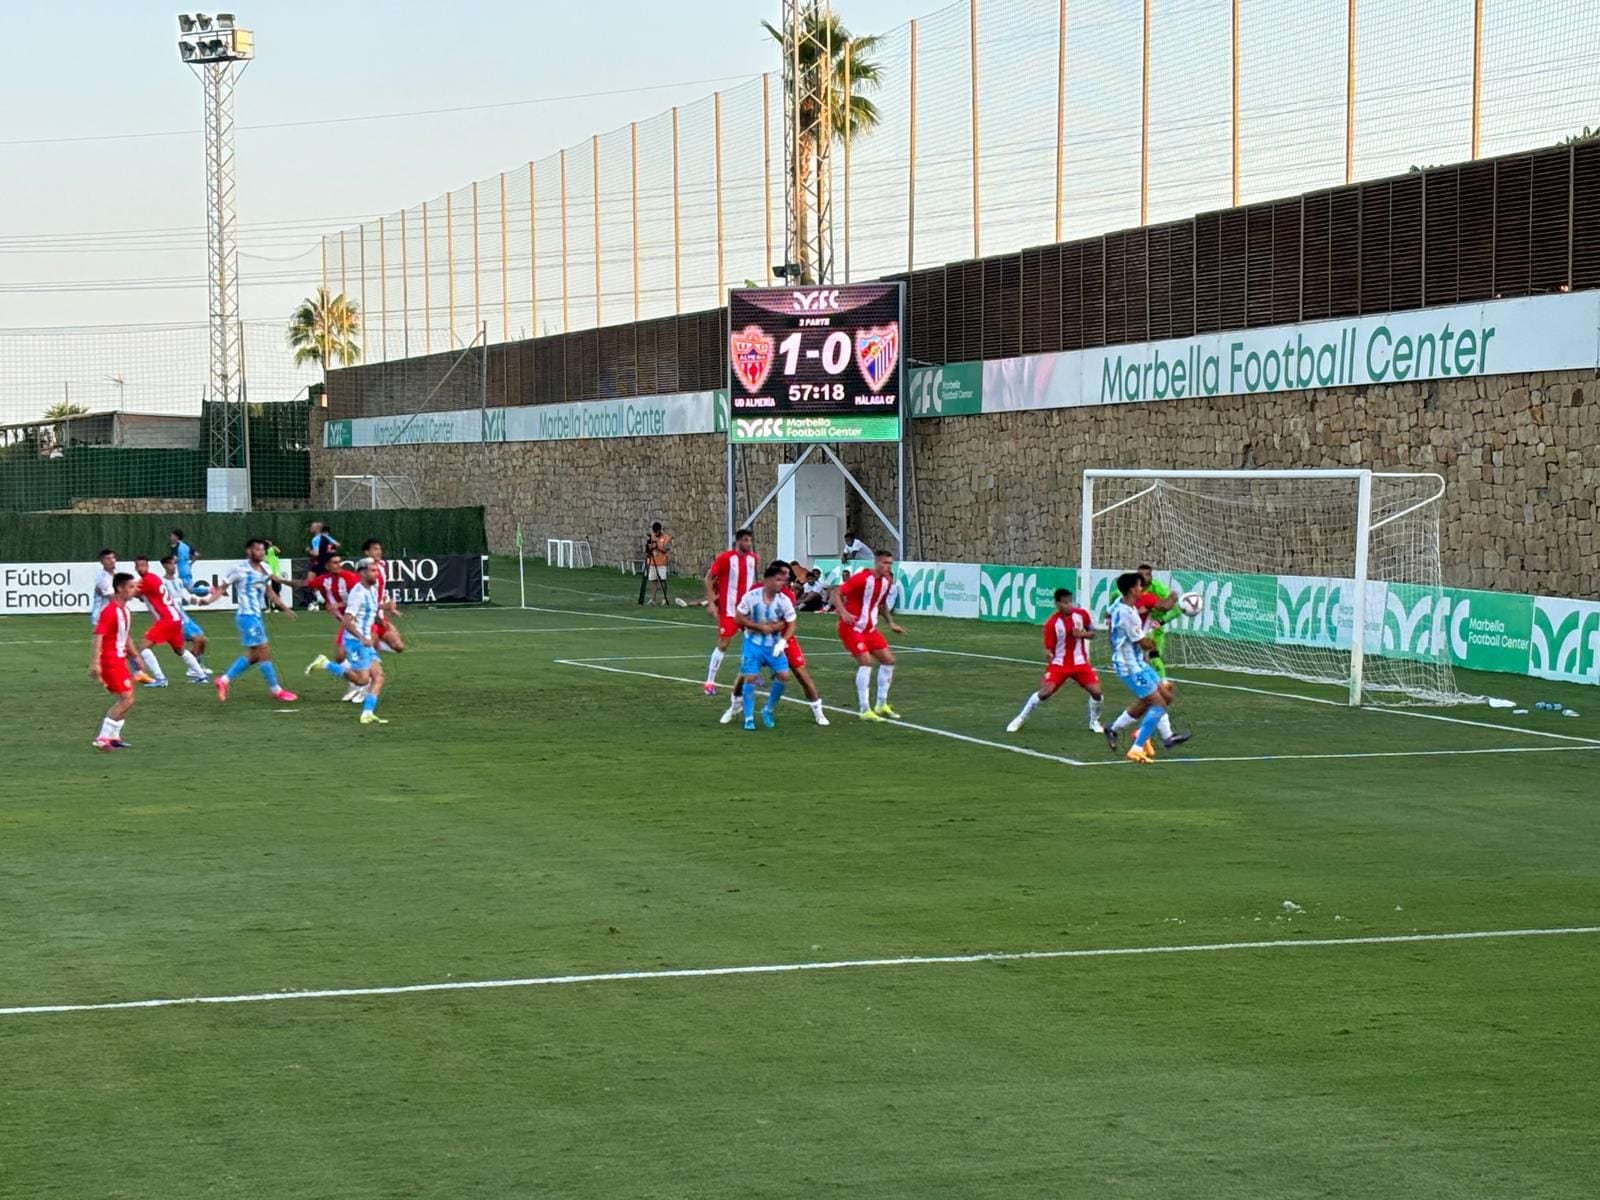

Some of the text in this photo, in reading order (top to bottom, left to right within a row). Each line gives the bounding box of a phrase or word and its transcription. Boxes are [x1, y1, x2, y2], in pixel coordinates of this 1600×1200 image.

[806, 318, 830, 326] PARTE
[1101, 321, 1496, 403] Marbella Football Center
[788, 383, 846, 401] 57:18
[885, 395, 896, 405] CF
[734, 398, 745, 408] UD
[540, 401, 666, 438] Marbella Football Center
[787, 417, 832, 427] Marbella
[787, 426, 862, 437] Football Center
[5, 569, 71, 587] Fútbol
[6, 589, 90, 608] Emotion
[1469, 618, 1505, 633] Marbella
[1469, 631, 1530, 650] Football Center
